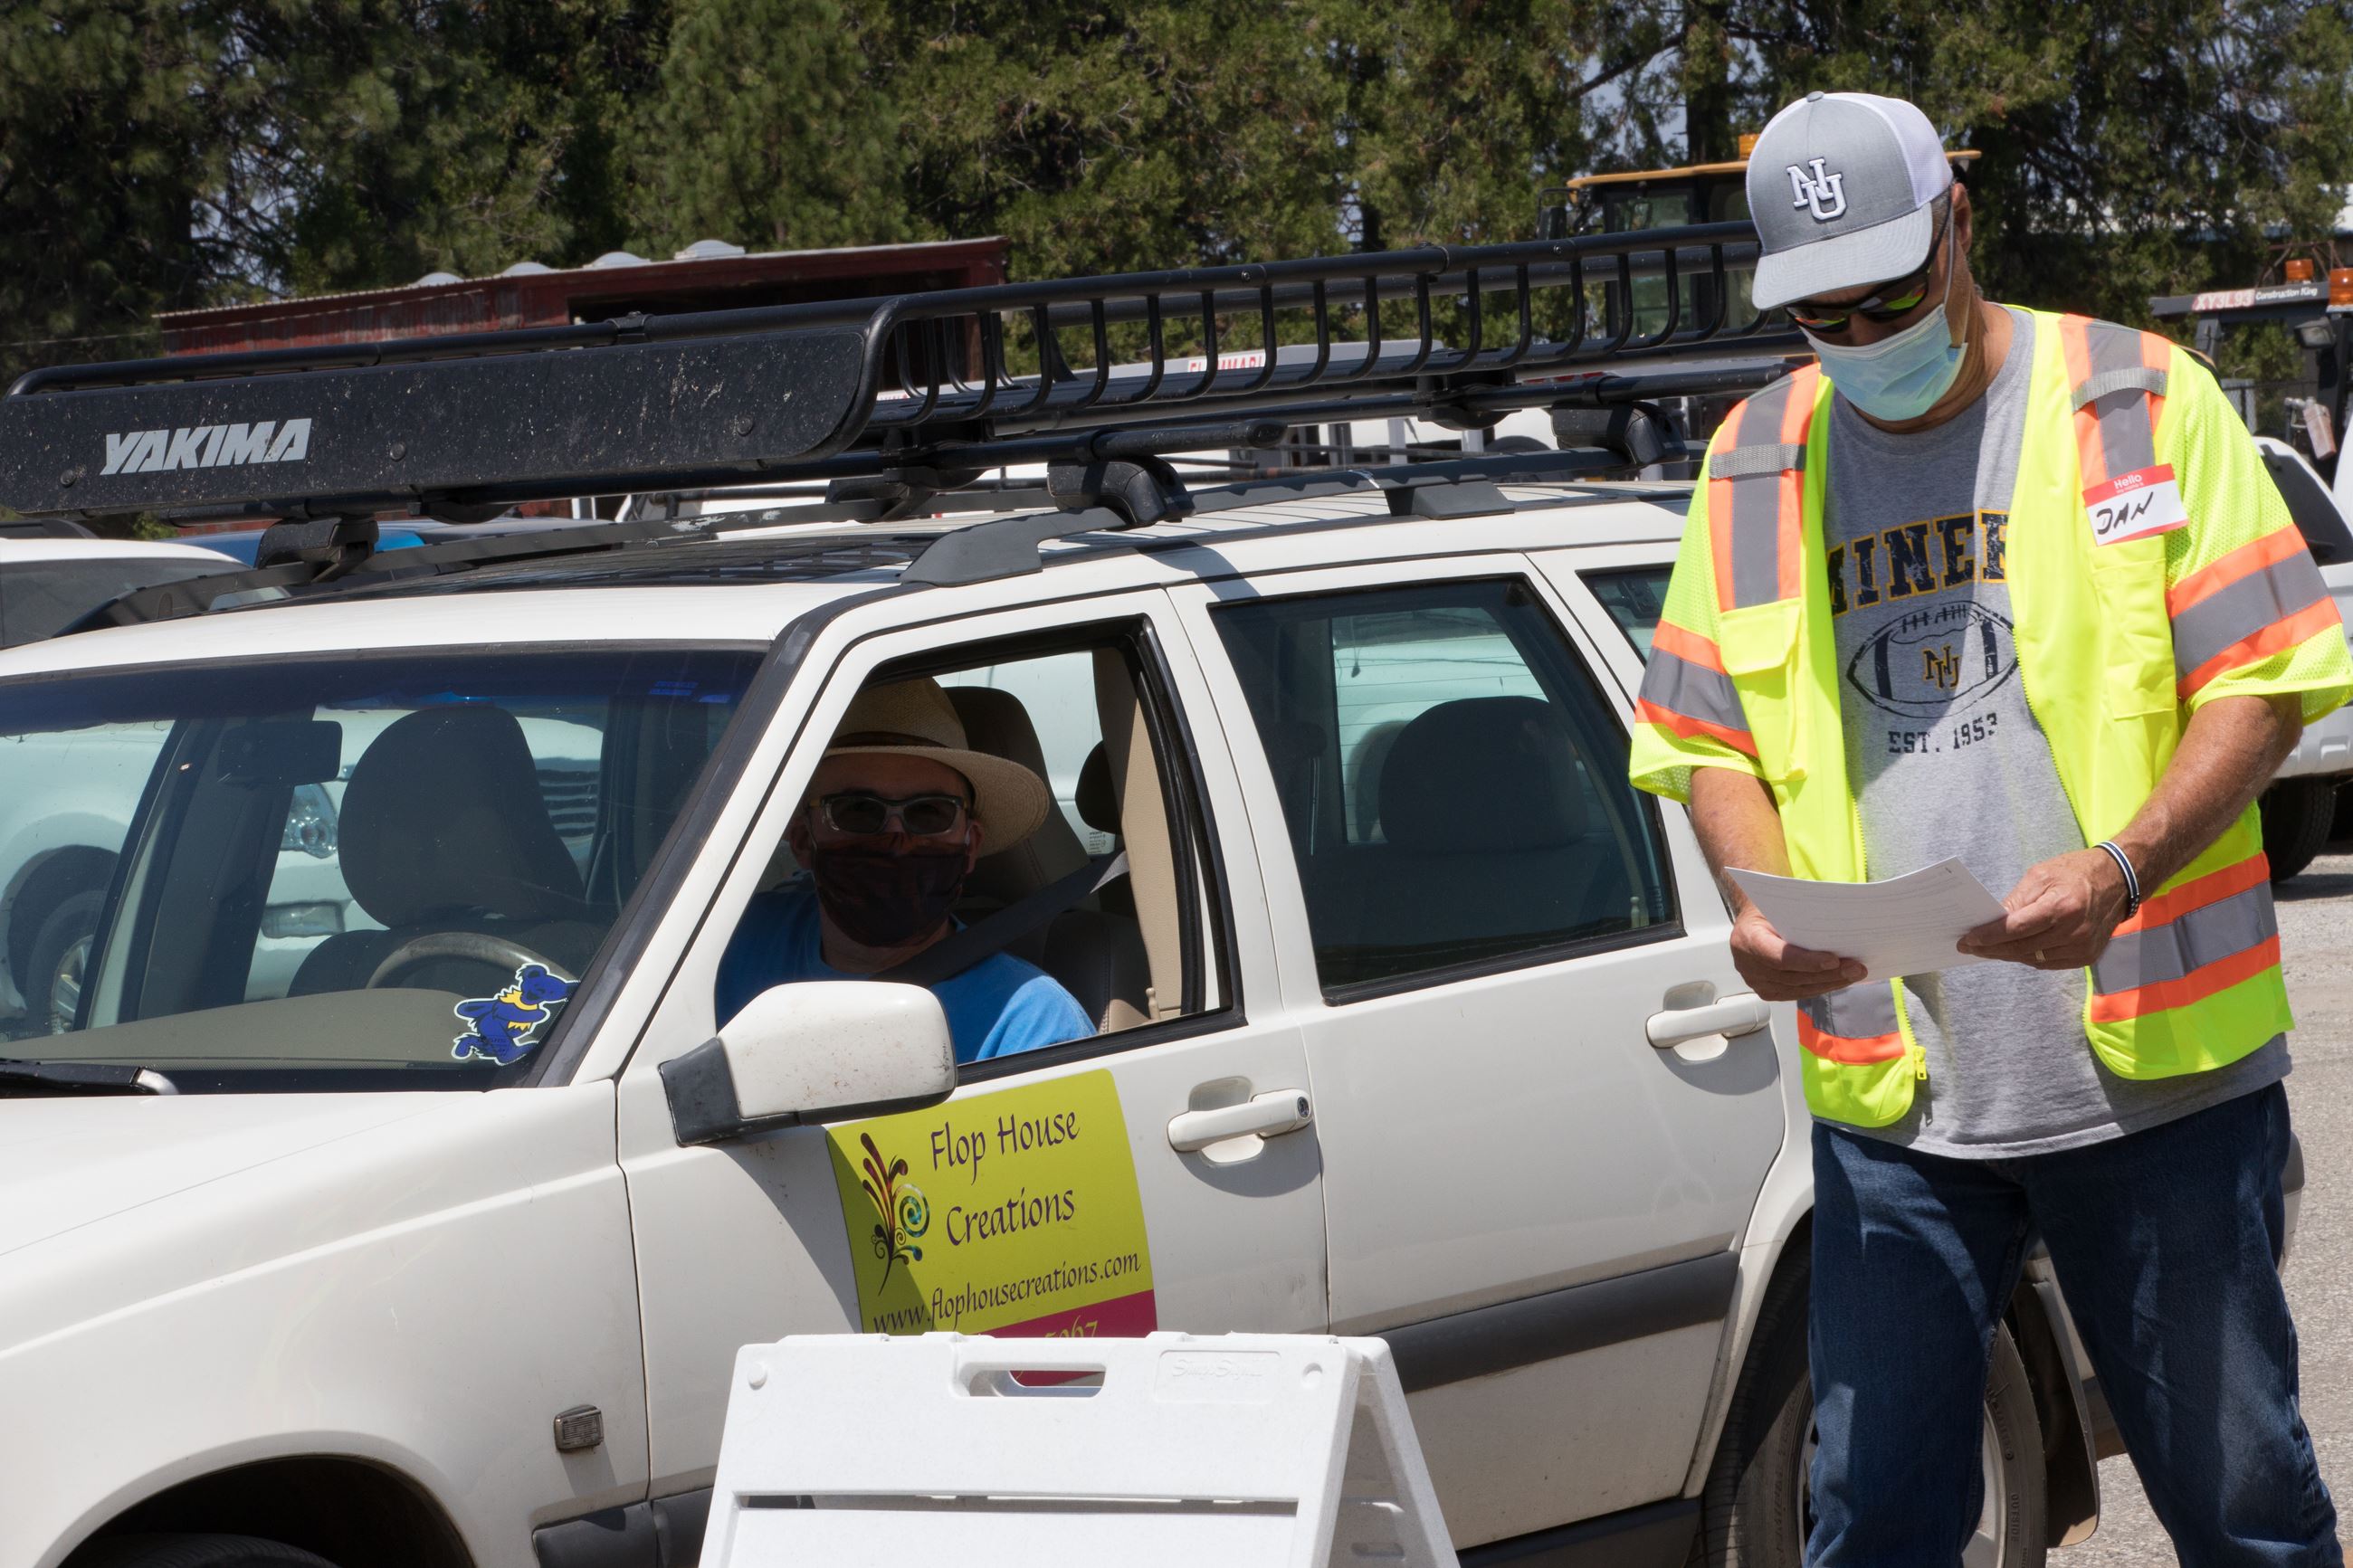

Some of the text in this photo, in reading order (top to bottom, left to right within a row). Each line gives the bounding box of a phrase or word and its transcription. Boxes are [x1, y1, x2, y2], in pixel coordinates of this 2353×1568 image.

[2255, 289, 2300, 300] Construction
[2300, 286, 2319, 298] King
[100, 418, 312, 476] YAKIMA
[2113, 474, 2143, 489] Hello
[1888, 730, 1940, 753] EST.
[930, 1111, 1081, 1186] Flop House
[947, 1187, 1075, 1246] Creations
[873, 1252, 1142, 1333] www.flophousecreations.com
